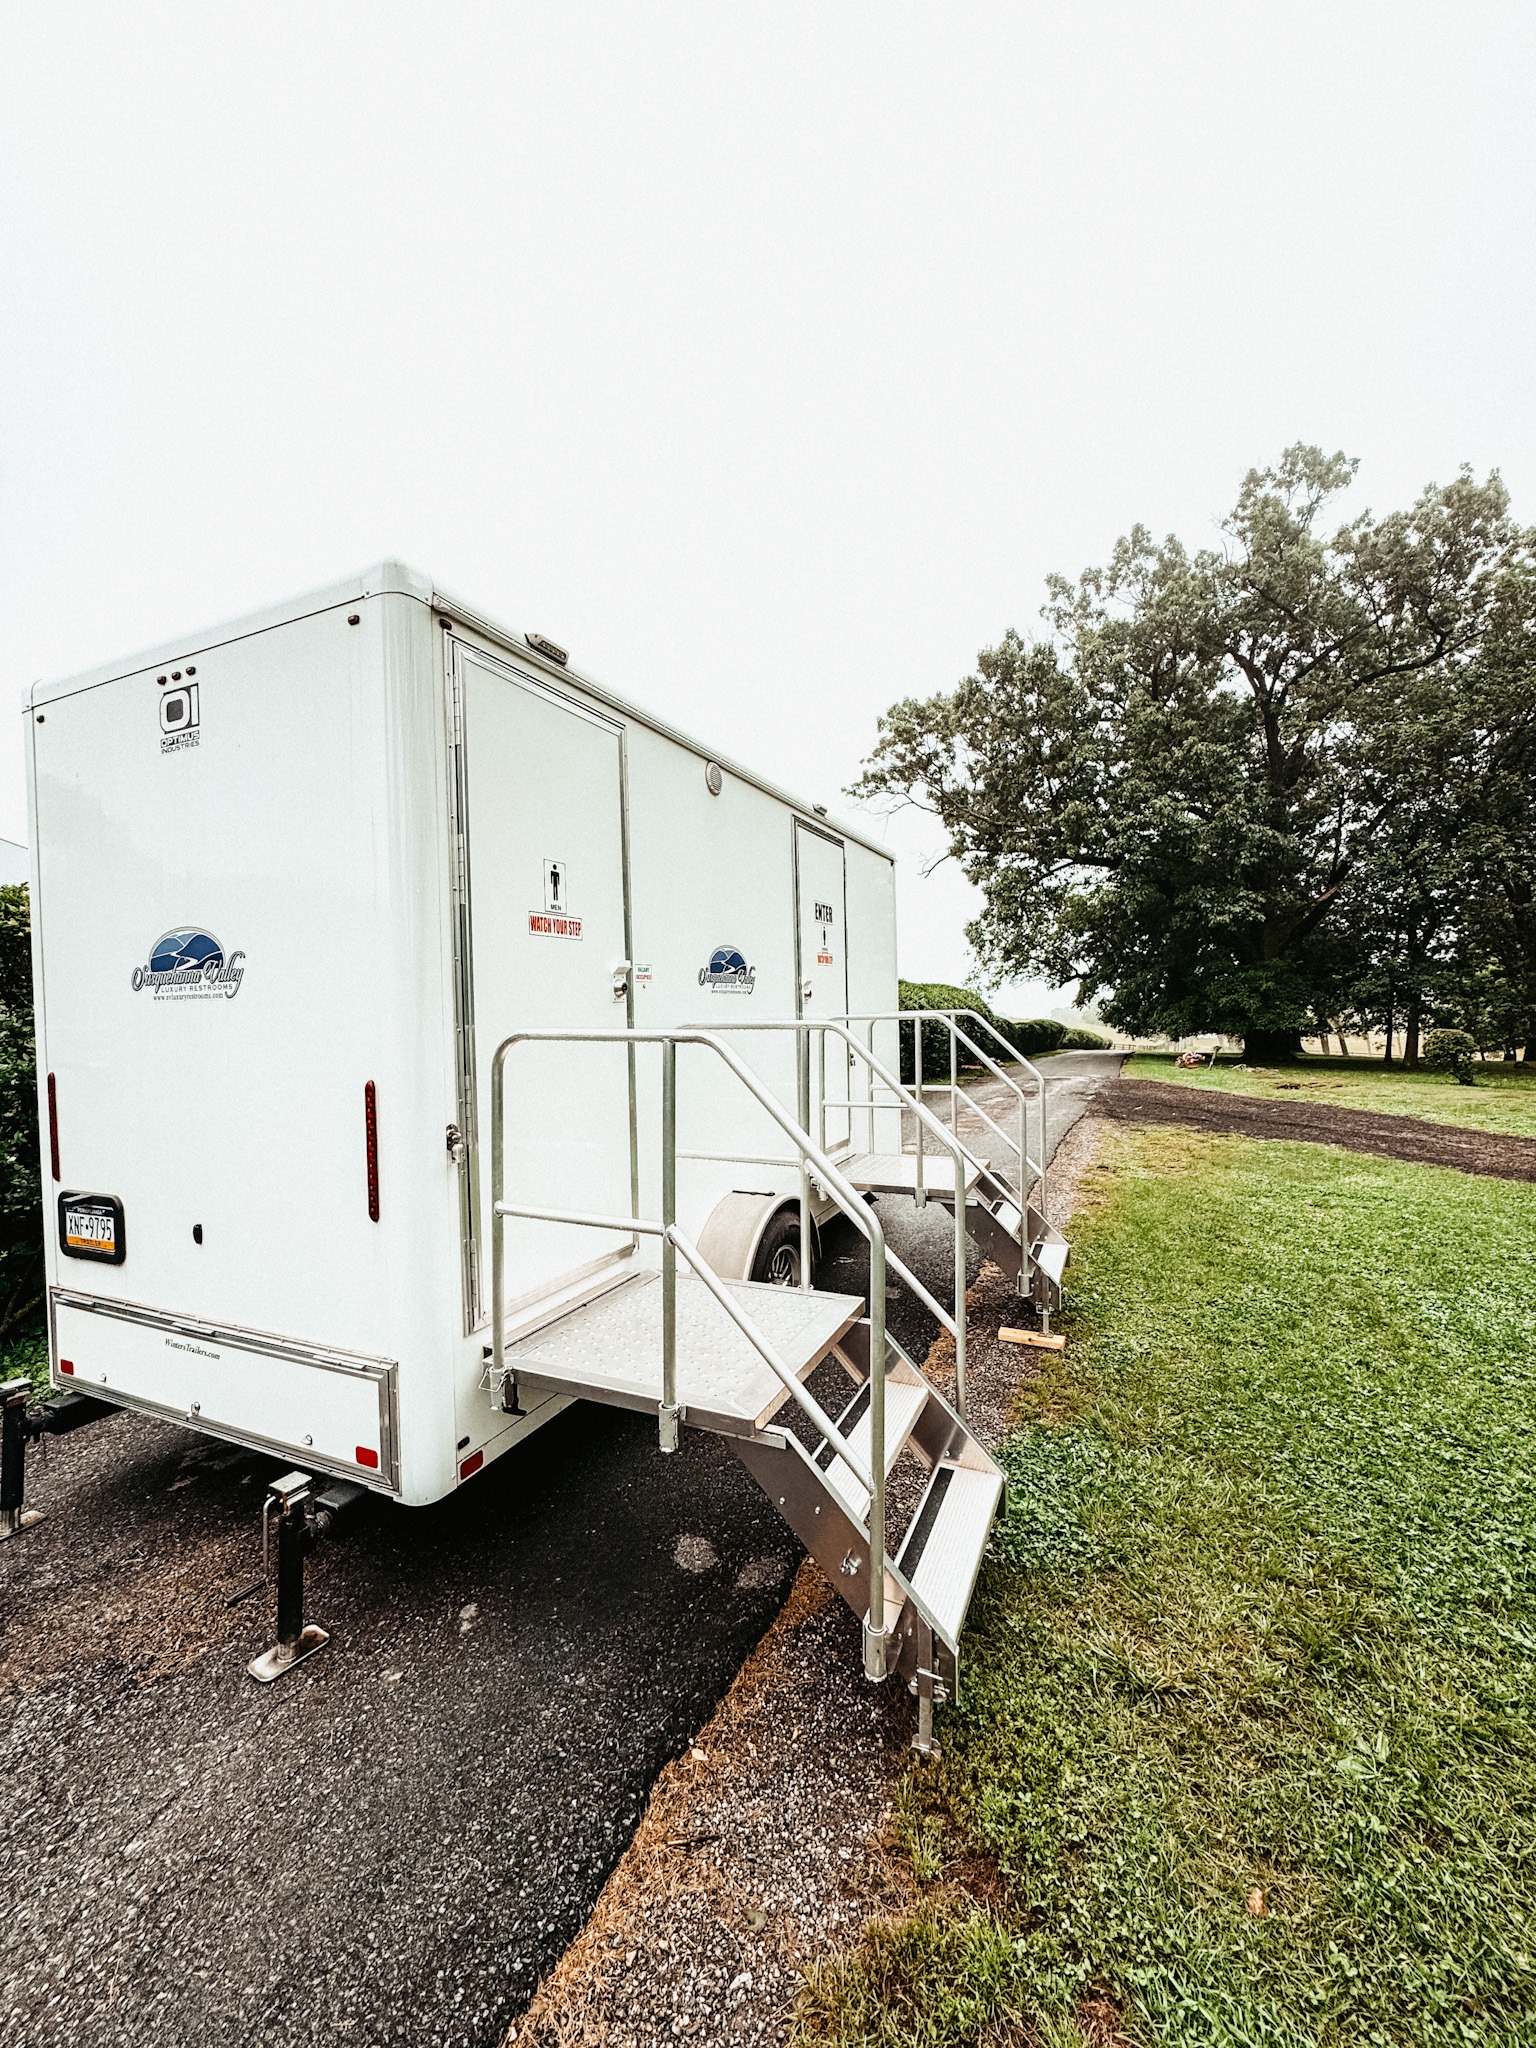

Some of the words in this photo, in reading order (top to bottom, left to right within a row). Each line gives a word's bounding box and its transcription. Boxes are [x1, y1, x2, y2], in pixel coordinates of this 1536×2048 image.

[160, 730, 200, 748] OPTIMUS
[161, 740, 200, 754] INDUSTRIES
[550, 903, 562, 911] MEN
[815, 902, 833, 923] ENTER
[530, 916, 552, 933] WATCH
[553, 918, 568, 935] YOUR
[568, 920, 582, 937] STEP
[131, 956, 202, 994] Susquehanna
[202, 950, 246, 999] Valley
[161, 985, 187, 993] LUXURY
[189, 983, 233, 991] RESTROOMS
[165, 1338, 221, 1360] WintersTrailers.com
